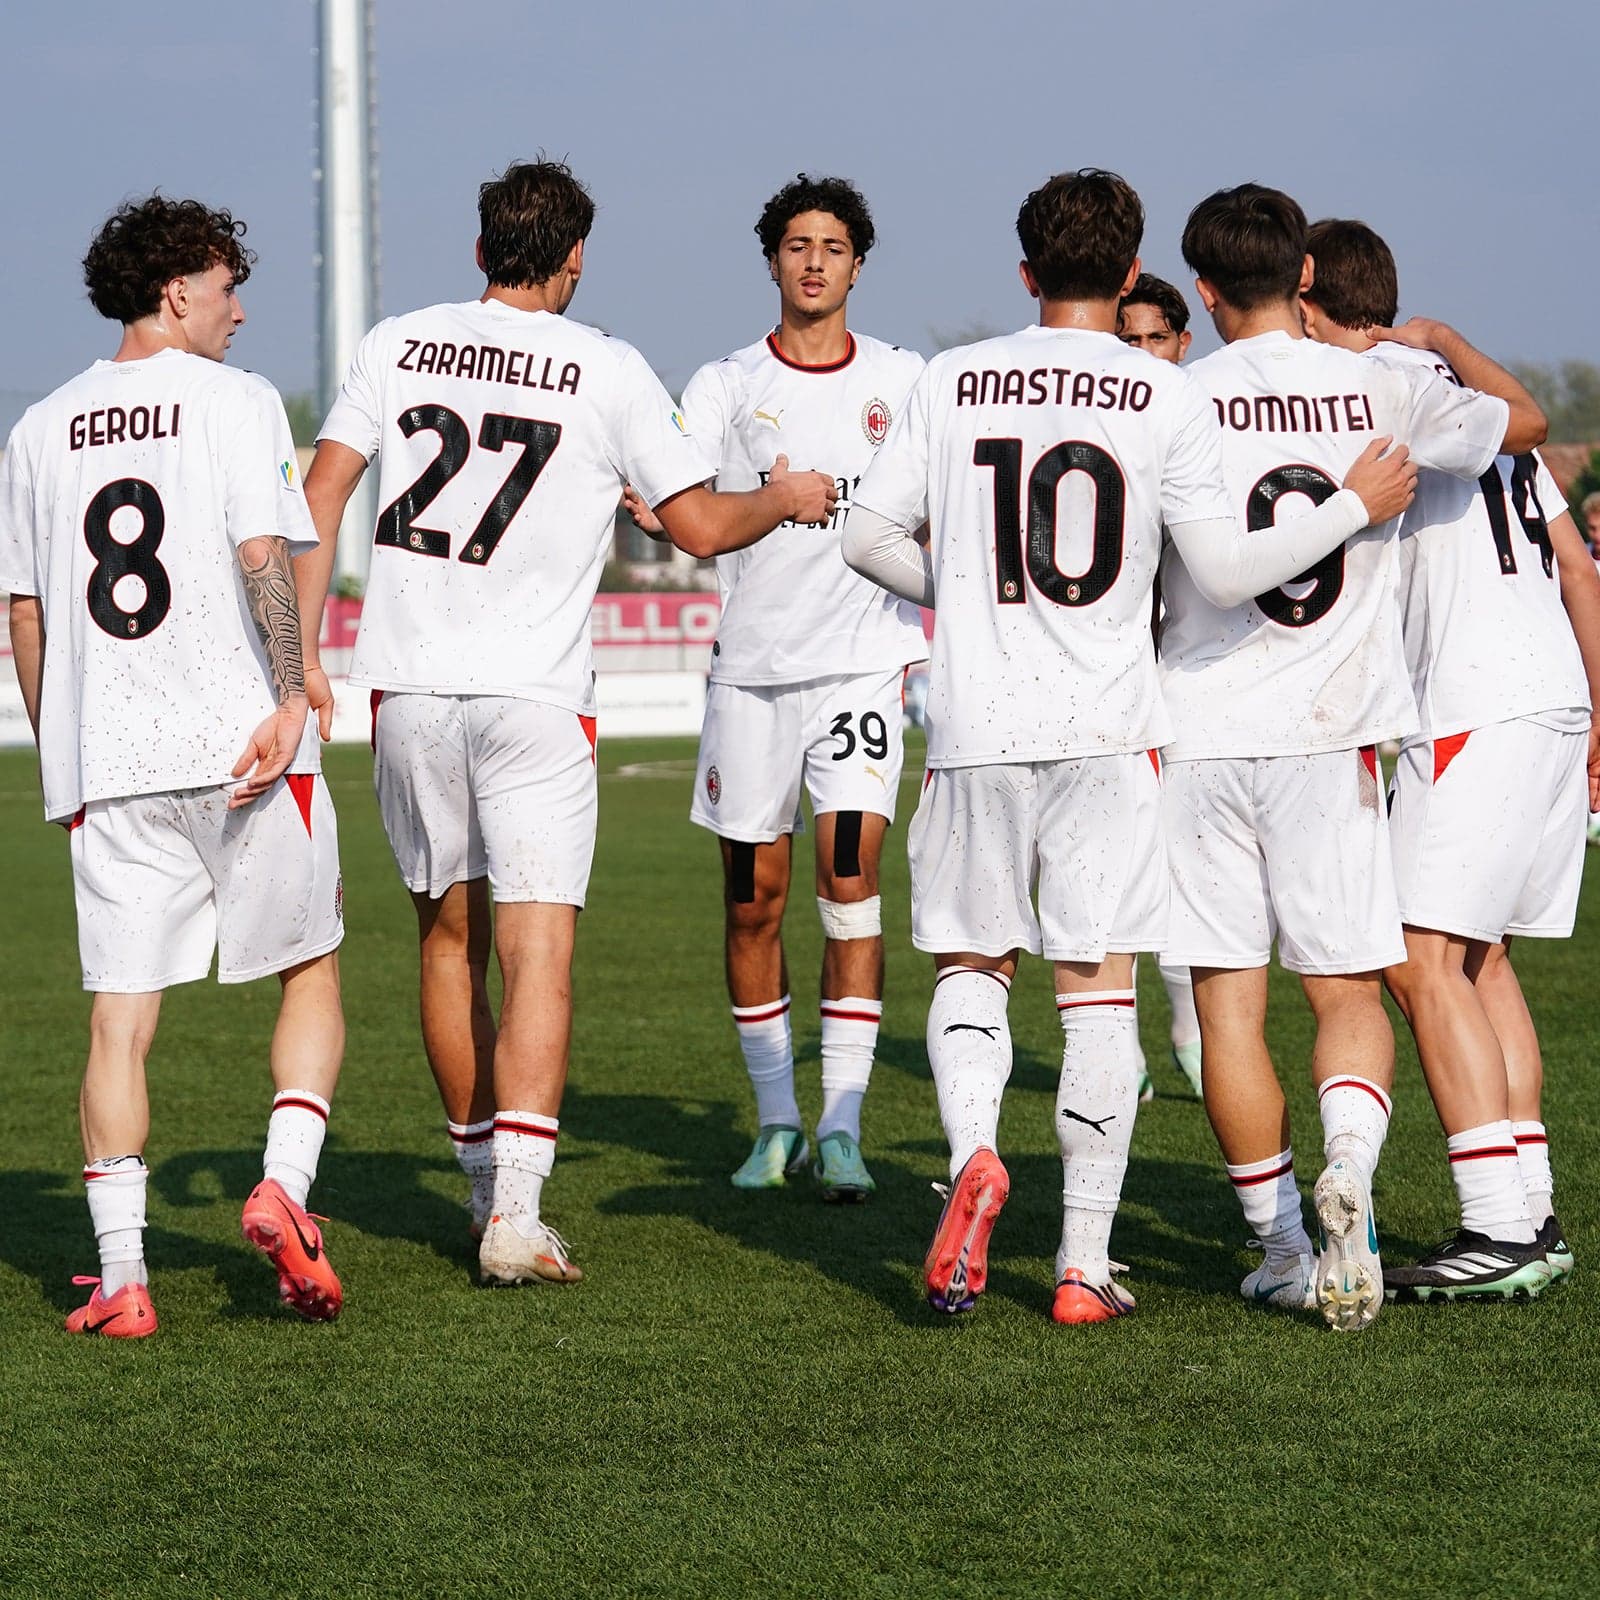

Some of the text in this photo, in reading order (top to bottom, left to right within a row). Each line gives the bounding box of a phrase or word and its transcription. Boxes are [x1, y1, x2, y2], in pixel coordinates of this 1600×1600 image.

[69, 404, 180, 451] GEROLI
[397, 339, 581, 395] ZARAMELLA
[957, 368, 1153, 412] ANASTASIO
[375, 403, 562, 566] 27
[974, 437, 1129, 608] 10
[1247, 463, 1346, 628] 9
[1479, 453, 1554, 579] 14
[83, 477, 172, 641] 8
[829, 711, 888, 761] 39
